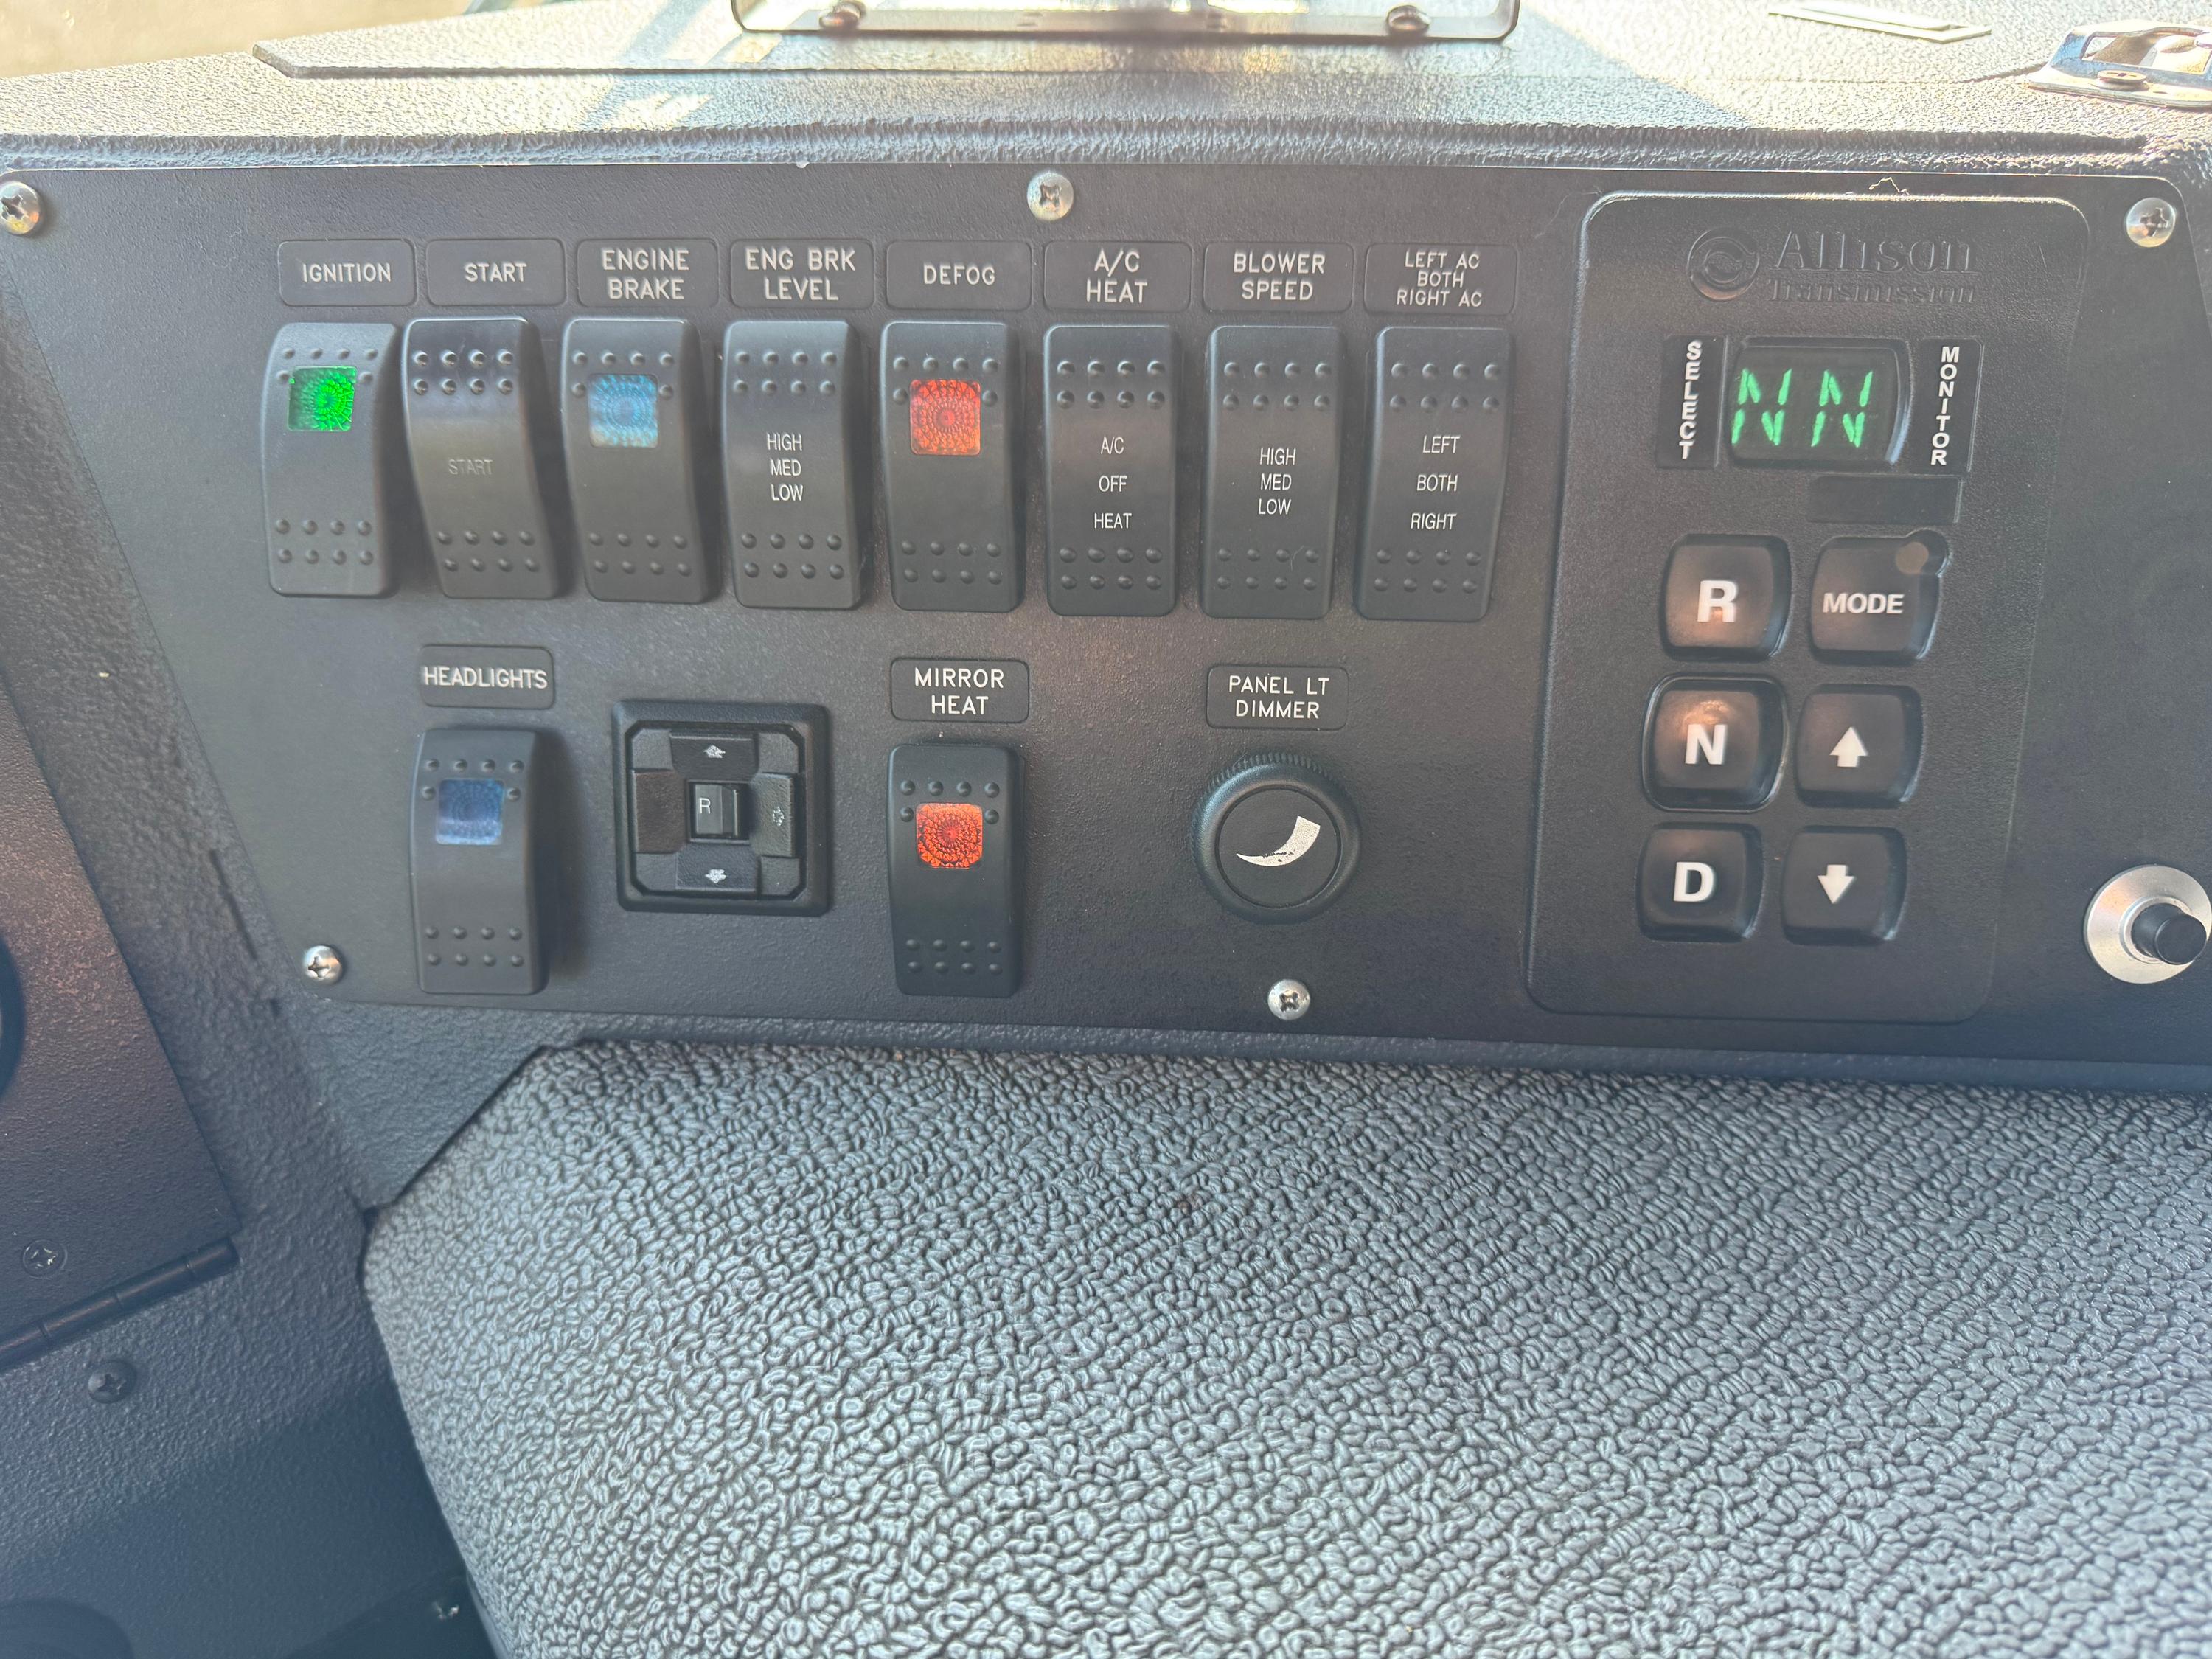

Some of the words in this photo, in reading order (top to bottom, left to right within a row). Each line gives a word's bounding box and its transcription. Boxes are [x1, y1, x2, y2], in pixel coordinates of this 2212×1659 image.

[602, 248, 689, 271] ENGINE
[745, 248, 794, 271] ENG
[809, 248, 856, 271] BRK
[1093, 249, 1140, 277] A/C
[1233, 251, 1326, 274] BLOWER
[1405, 251, 1447, 268] LEFT
[1455, 251, 1481, 269] AC
[302, 262, 392, 283] IGNITION
[464, 262, 526, 283] START
[923, 262, 995, 285] DEFOG
[1417, 271, 1464, 288] BOTH
[608, 276, 684, 301] BRAKE
[765, 277, 839, 301] LEVEL
[1085, 280, 1148, 304] HEAT
[1241, 281, 1313, 301] SPEED
[1397, 288, 1450, 307] RIGHT
[1458, 290, 1483, 307] AC
[1678, 340, 1703, 460] SELECT
[1930, 346, 1961, 466] MONITOR
[766, 432, 804, 451] HIGH
[1100, 437, 1125, 455] A/C
[1422, 436, 1460, 454] LEFT
[1259, 448, 1296, 466] HIGH
[448, 459, 493, 476] START
[770, 459, 802, 476] MED
[1098, 475, 1128, 493] OFF
[1259, 473, 1293, 491] MED
[1416, 474, 1458, 493] BOTH
[771, 484, 804, 502] LOW
[1258, 498, 1292, 516] LOW
[1093, 512, 1133, 529] HEAT
[1410, 512, 1457, 531] RIGHT
[1697, 580, 1738, 623] R
[1822, 593, 1905, 614] MODE
[422, 666, 549, 689] HEADLIGHTS
[914, 667, 1004, 689] MIRROR
[1228, 675, 1294, 694] PANEL
[1306, 678, 1330, 696] LT
[931, 696, 989, 715] HEAT
[1234, 700, 1320, 720] DIMMER
[1685, 723, 1728, 765] N
[698, 798, 712, 814] R
[1673, 861, 1717, 902] D
